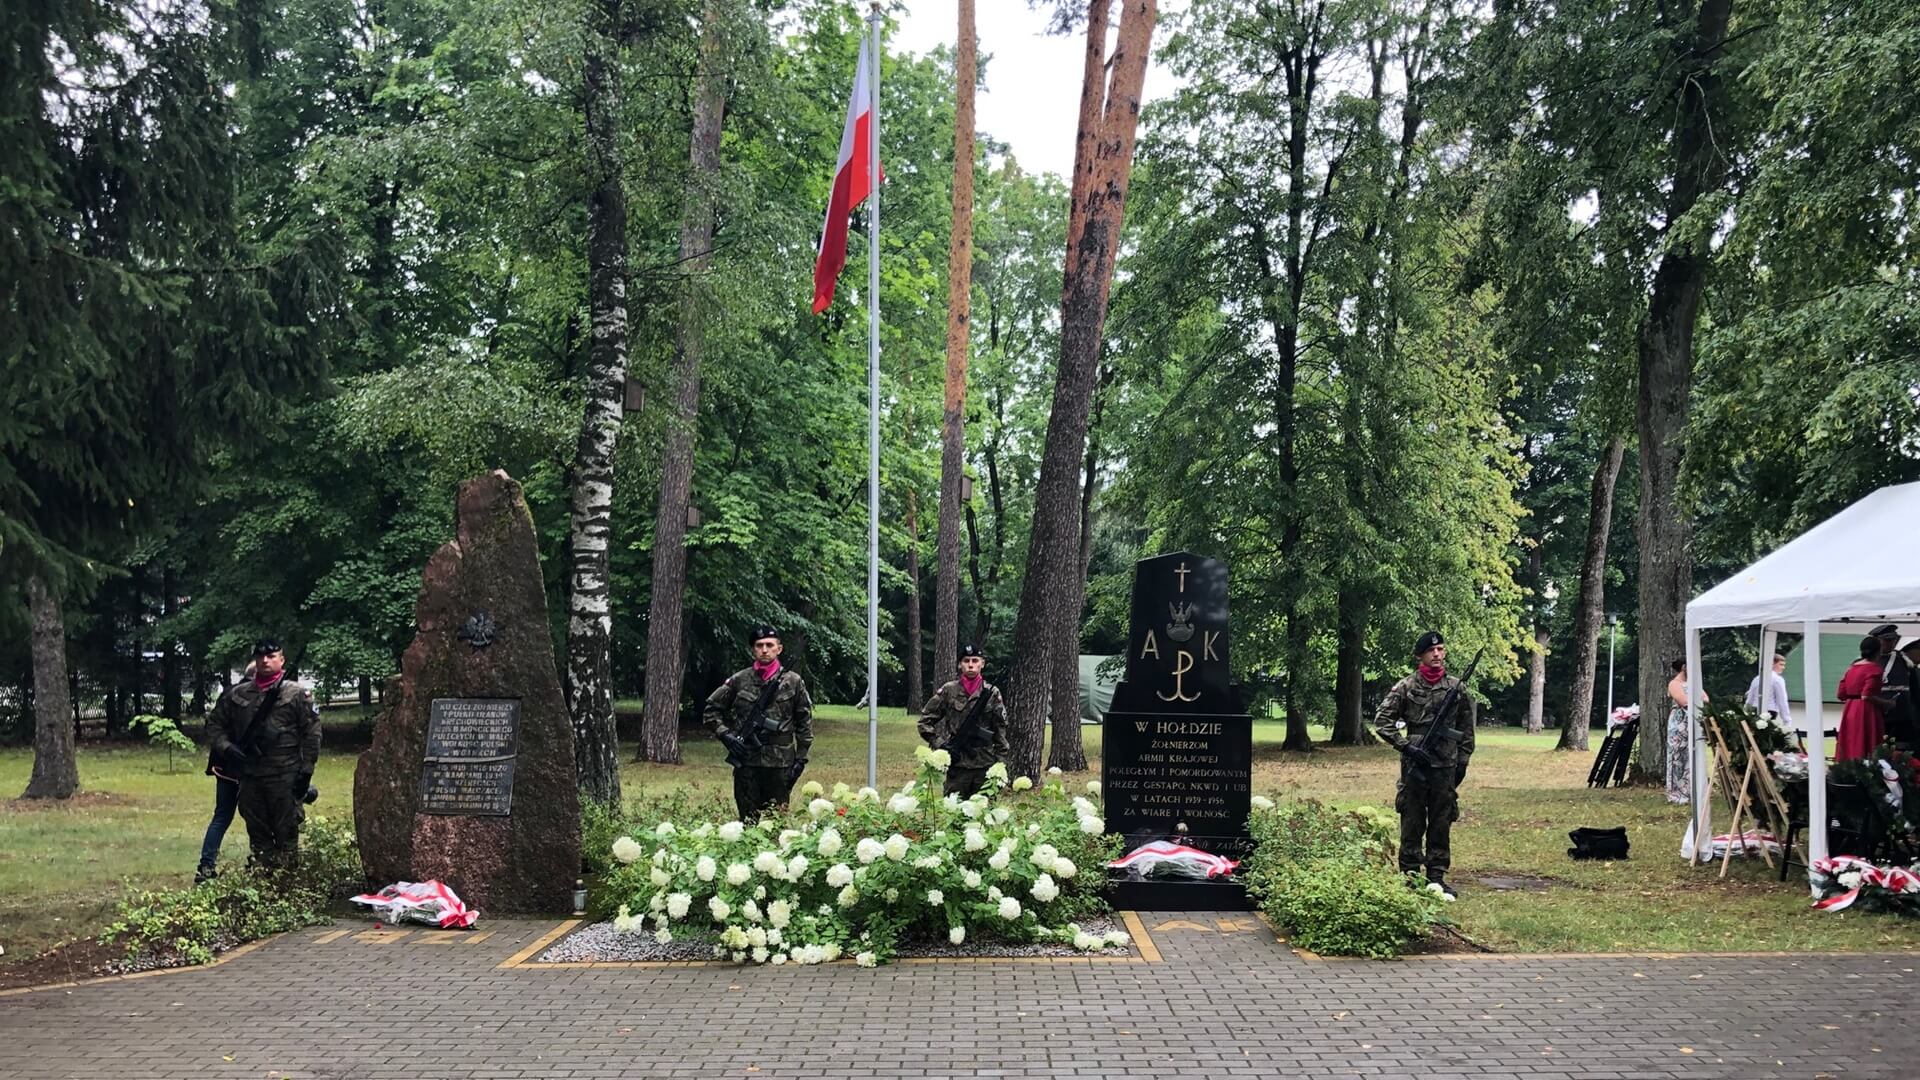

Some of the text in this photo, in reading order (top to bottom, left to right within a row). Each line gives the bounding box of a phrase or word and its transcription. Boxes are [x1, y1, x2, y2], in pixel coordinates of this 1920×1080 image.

[1140, 629, 1220, 662] A K
[1135, 721, 1223, 735] W HOŁDZIE
[1151, 739, 1209, 750] ŻOŁNIERZOM
[1138, 754, 1219, 764] ARMII KRAJOWEJ
[1109, 767, 1248, 778] POLEGŁYM I POMORDOWANYM
[1109, 780, 1139, 789] PRZEZ
[1190, 782, 1220, 792] NKWD
[1233, 783, 1248, 792] UB
[1130, 794, 1140, 802] W
[1143, 795, 1181, 804] LATACH
[1123, 807, 1136, 816] ZA
